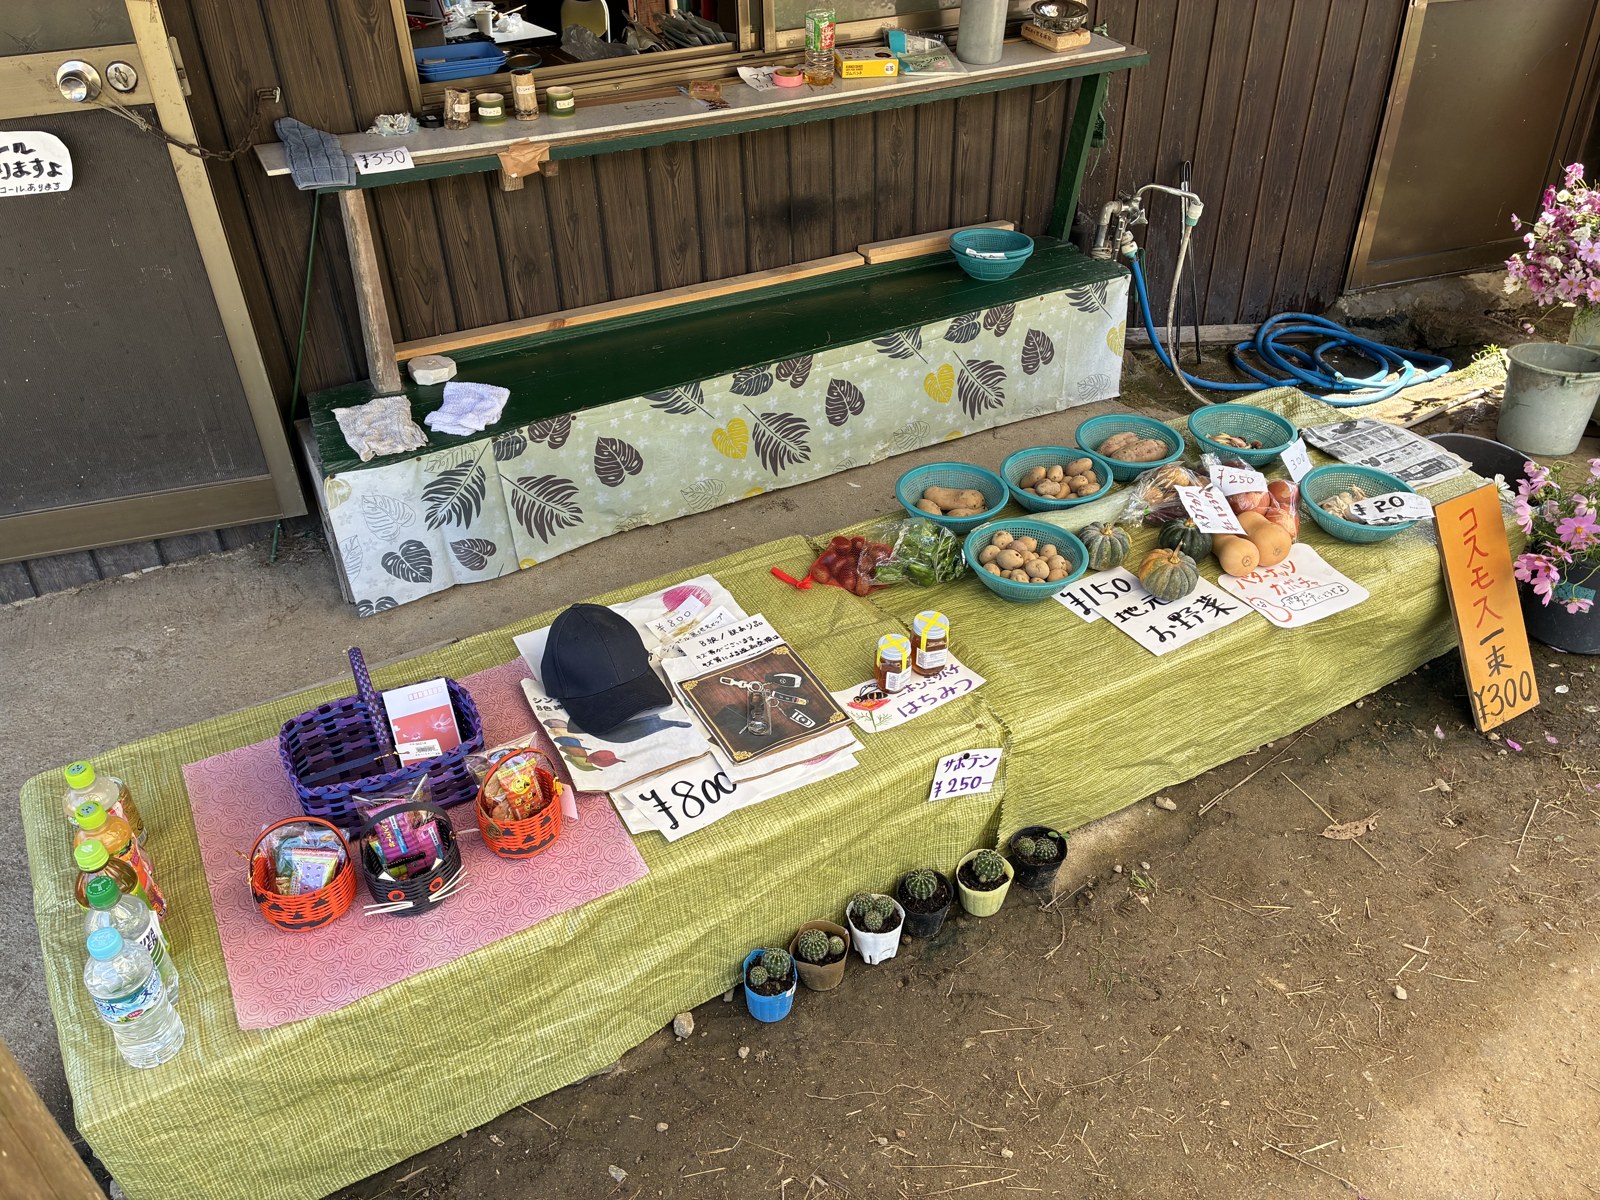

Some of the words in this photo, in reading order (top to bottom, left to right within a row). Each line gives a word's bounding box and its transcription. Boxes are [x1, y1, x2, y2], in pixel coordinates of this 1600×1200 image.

[359, 150, 405, 169] ¥350
[1236, 560, 1297, 590] バターナッツ
[1059, 577, 1132, 616] ¥150
[1146, 593, 1238, 643] お野菜
[896, 678, 973, 718] はちみつ
[1474, 670, 1532, 725] ¥300
[638, 771, 737, 830] ¥800
